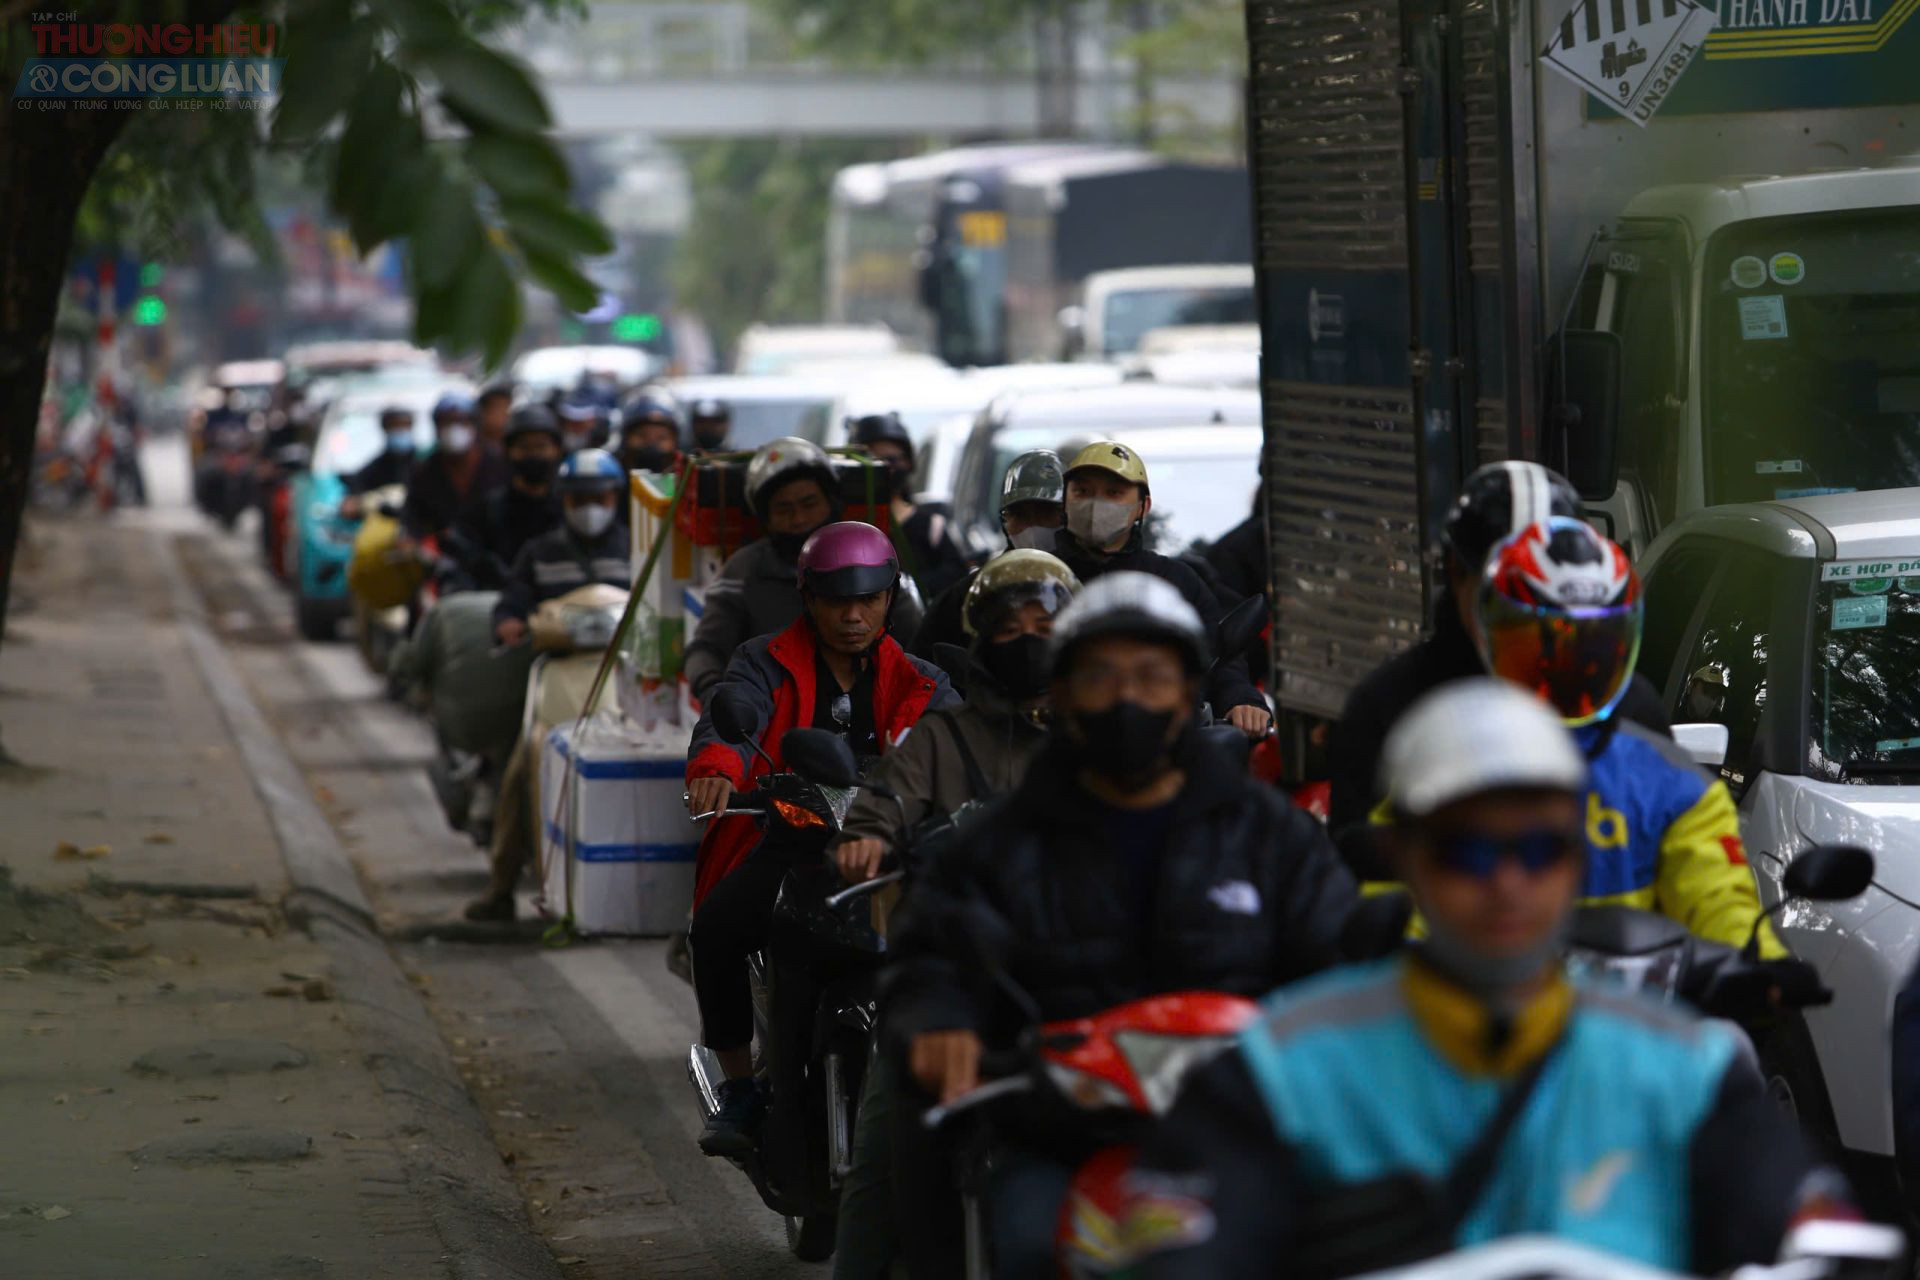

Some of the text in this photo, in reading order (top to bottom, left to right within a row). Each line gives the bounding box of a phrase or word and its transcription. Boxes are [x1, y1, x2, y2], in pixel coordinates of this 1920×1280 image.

[1619, 80, 1630, 97] 9
[1633, 42, 1698, 121] UN3481
[1829, 565, 1852, 577] XE
